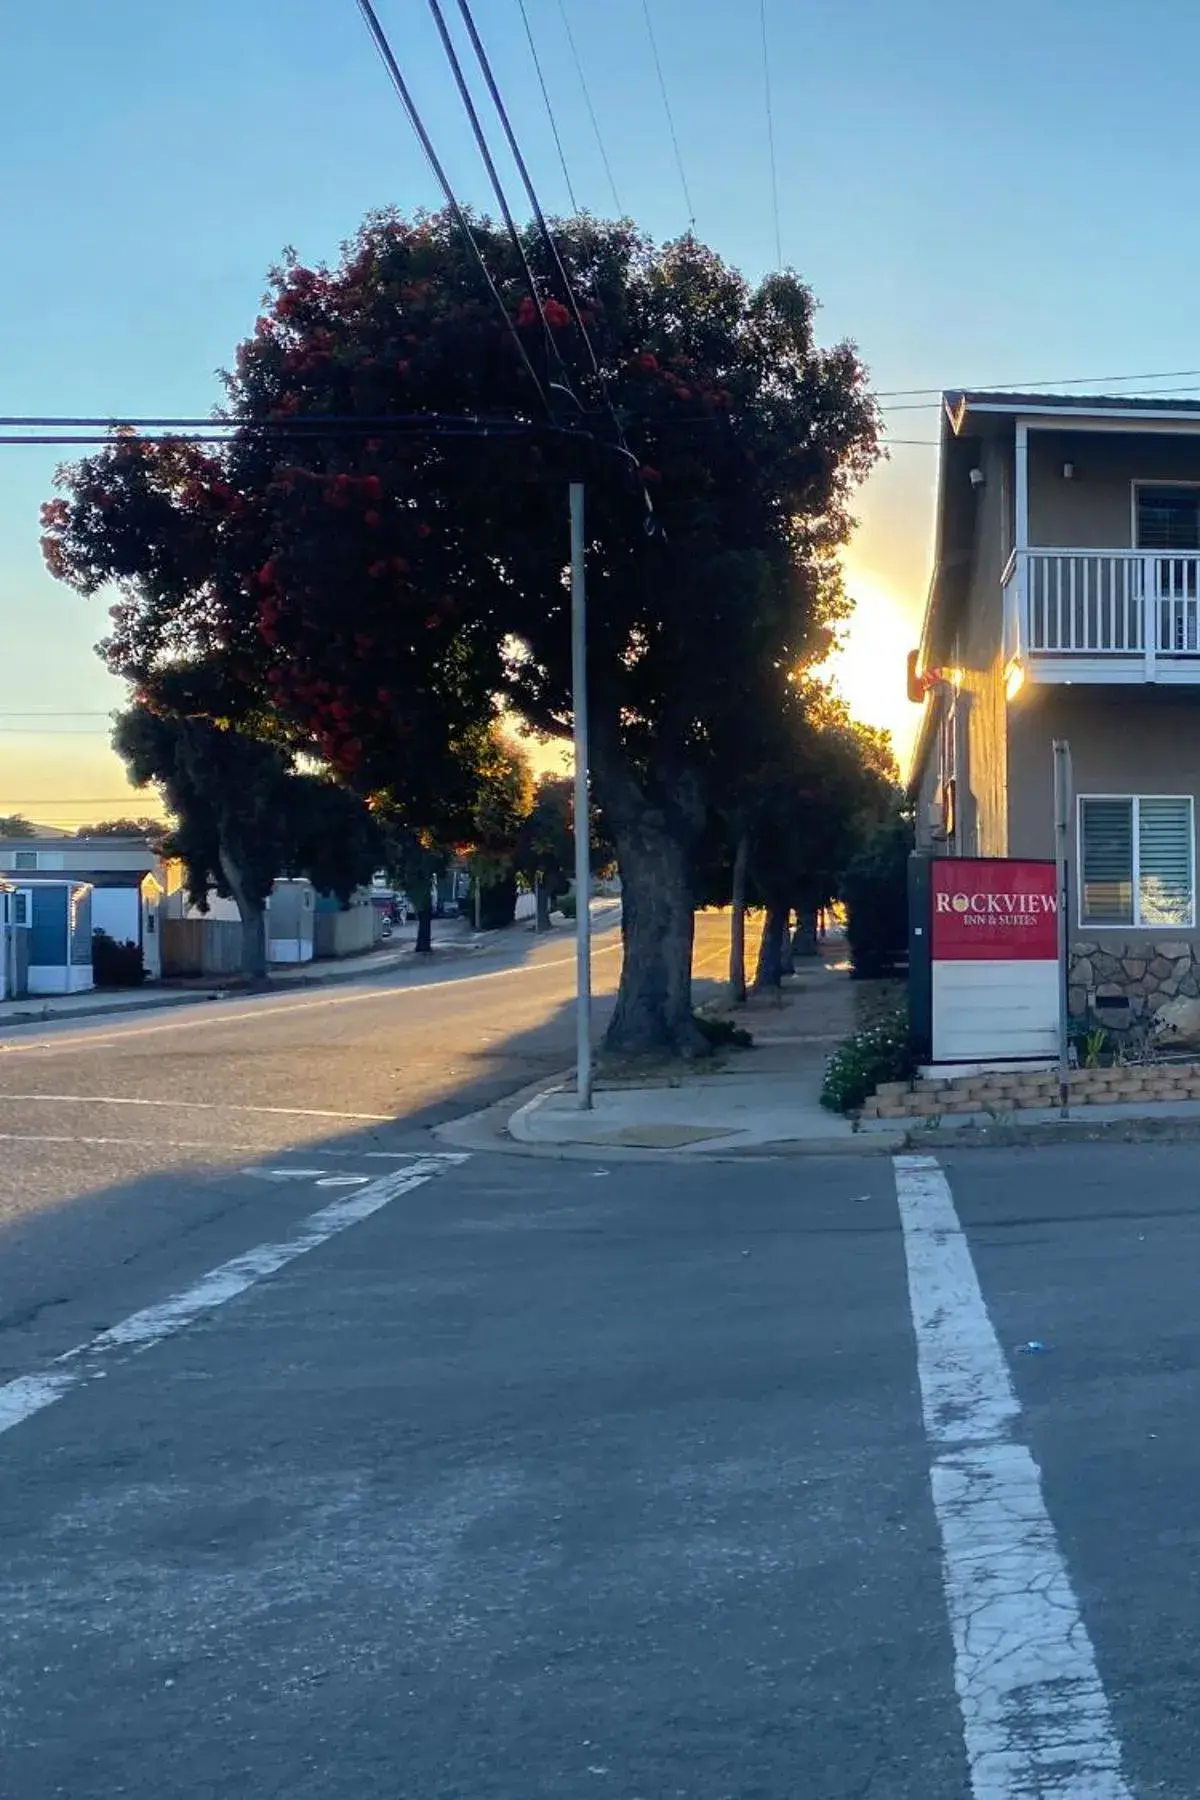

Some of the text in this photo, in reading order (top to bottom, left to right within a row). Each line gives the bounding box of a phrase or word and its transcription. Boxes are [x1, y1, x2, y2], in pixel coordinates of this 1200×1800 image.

[936, 892, 1058, 913] ROCKVIEW
[963, 914, 1037, 925] INN & SUITES
